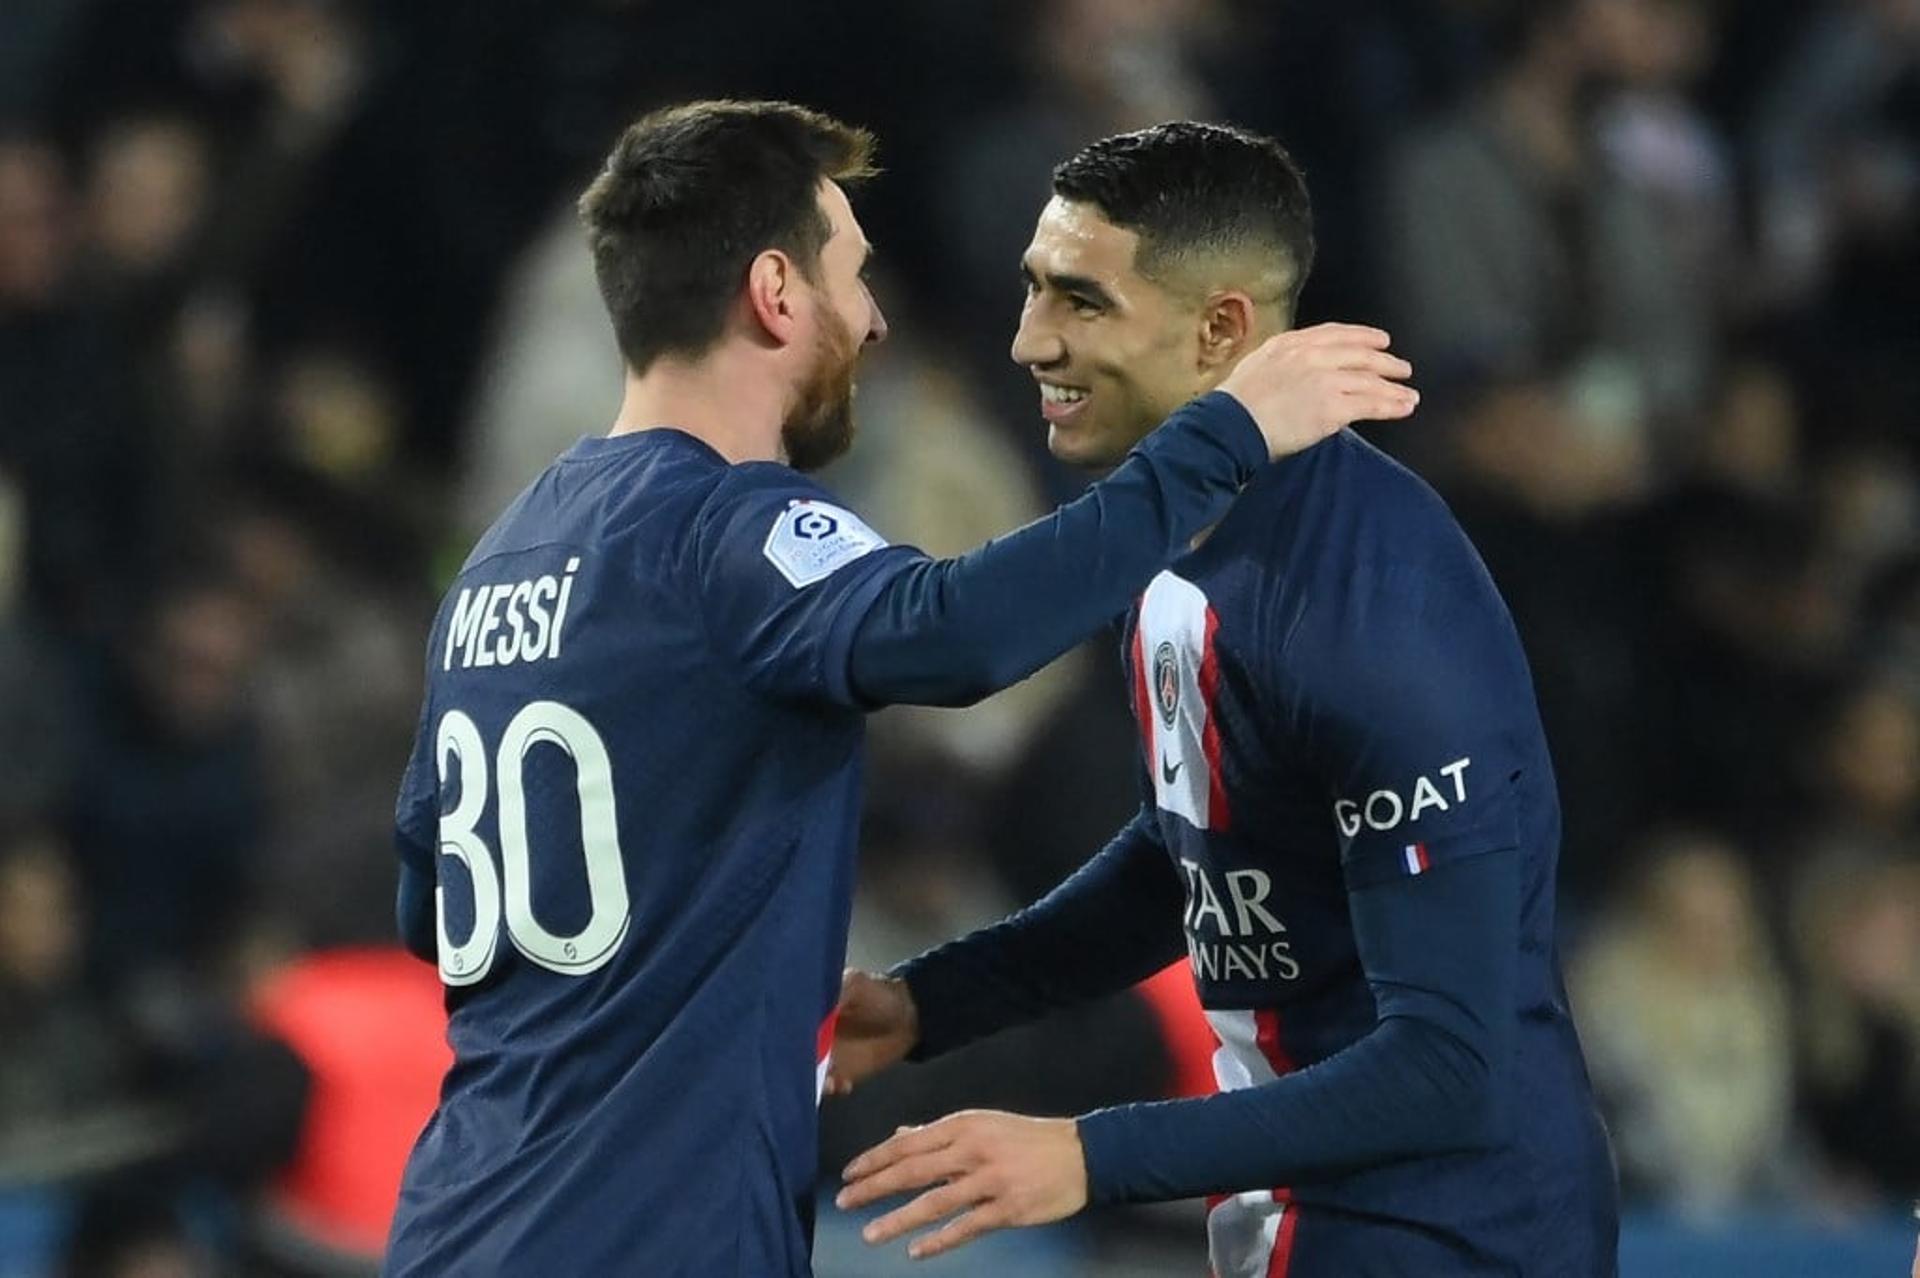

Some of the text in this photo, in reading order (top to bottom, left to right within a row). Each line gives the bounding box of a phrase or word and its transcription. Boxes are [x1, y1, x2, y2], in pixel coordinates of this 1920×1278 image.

[1334, 757, 1471, 837] GOAT
[436, 701, 631, 987] 30
[1185, 931, 1300, 981] WAYS
